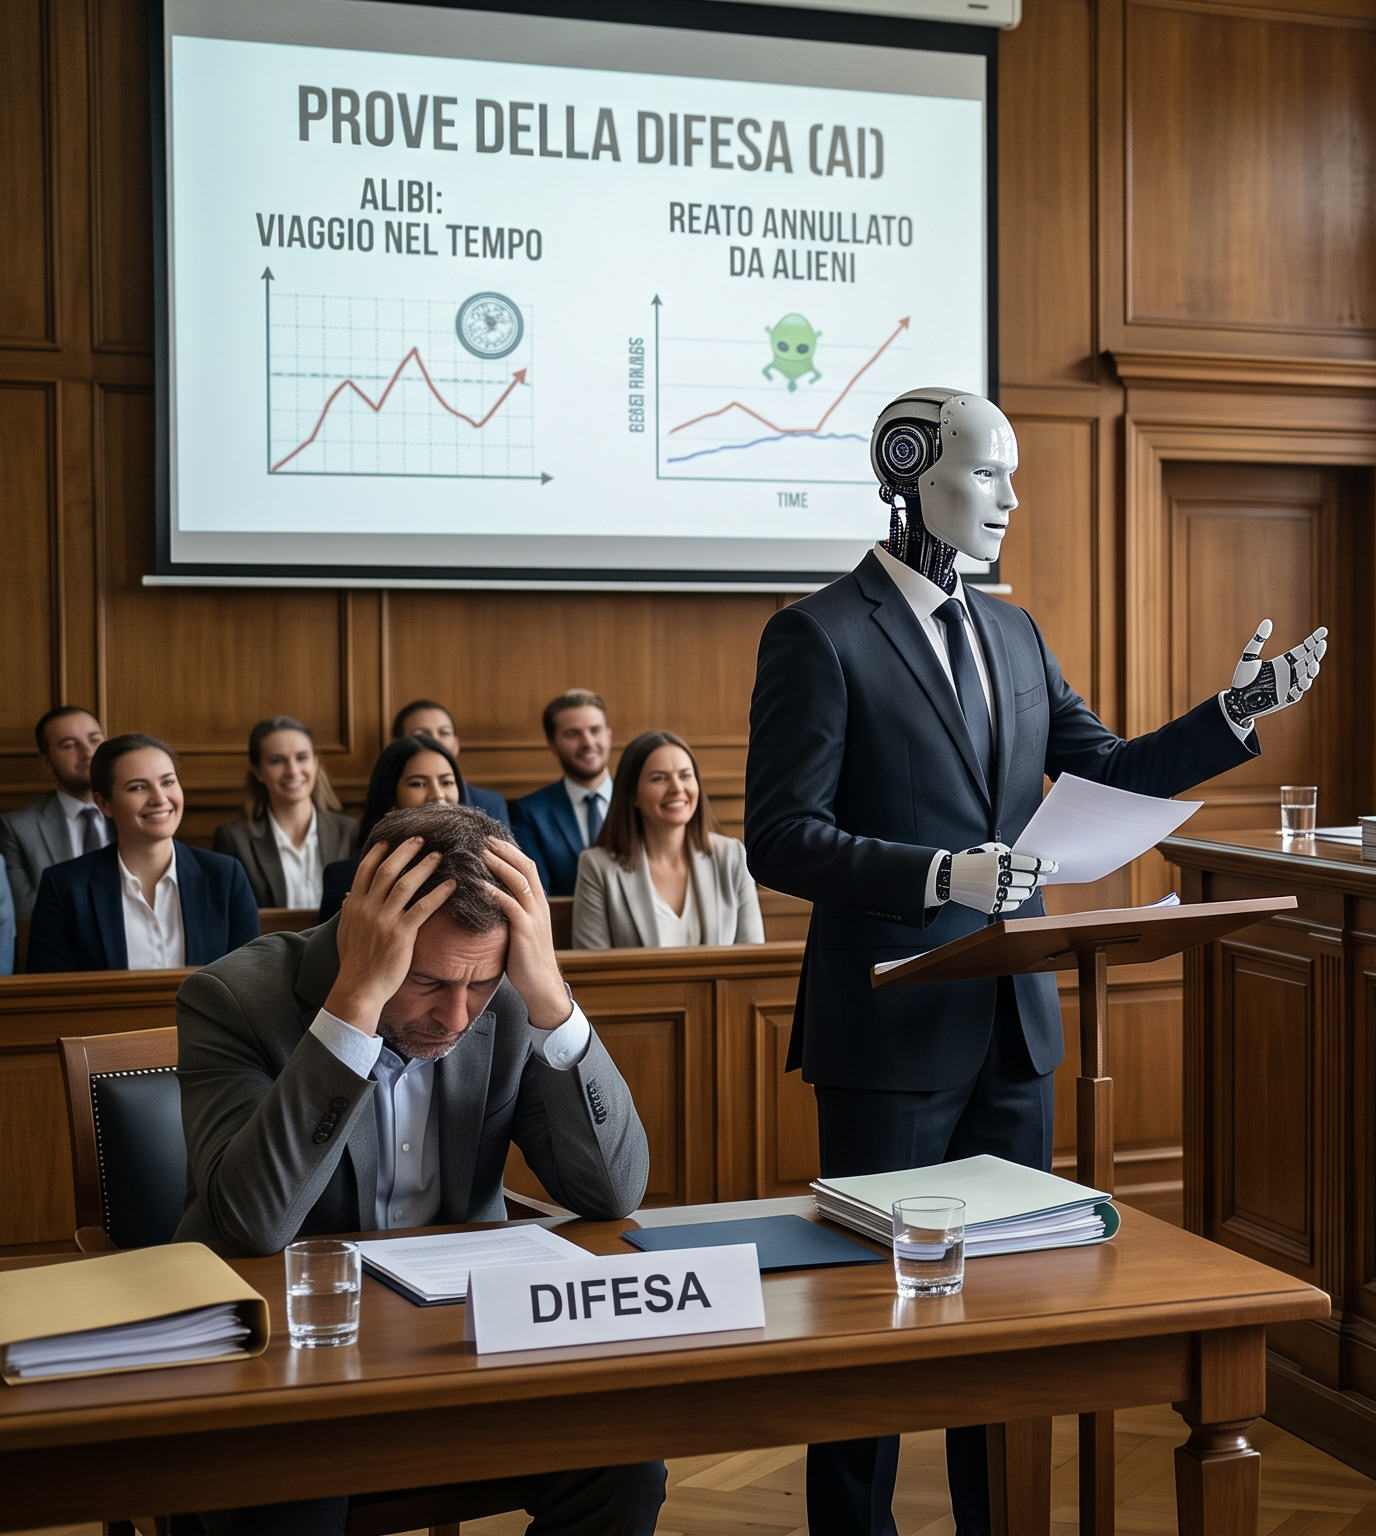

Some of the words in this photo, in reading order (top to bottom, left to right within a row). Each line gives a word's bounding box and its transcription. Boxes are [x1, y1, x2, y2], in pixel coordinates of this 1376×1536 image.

[298, 84, 459, 152] PROVE
[475, 98, 622, 163] DELLA
[637, 110, 794, 174] DIFESA
[808, 123, 884, 180] (AI)
[359, 177, 443, 215] ALIBI:
[255, 212, 374, 253] VIAGGIO
[384, 220, 439, 256] NEL
[446, 223, 543, 262] TEMPO
[669, 201, 753, 237] REATO
[762, 207, 913, 247] ANNULLATO
[729, 245, 765, 279] DA
[772, 248, 856, 284] ALIENI
[777, 491, 808, 508] TIME
[529, 1271, 712, 1324] DIFESA
